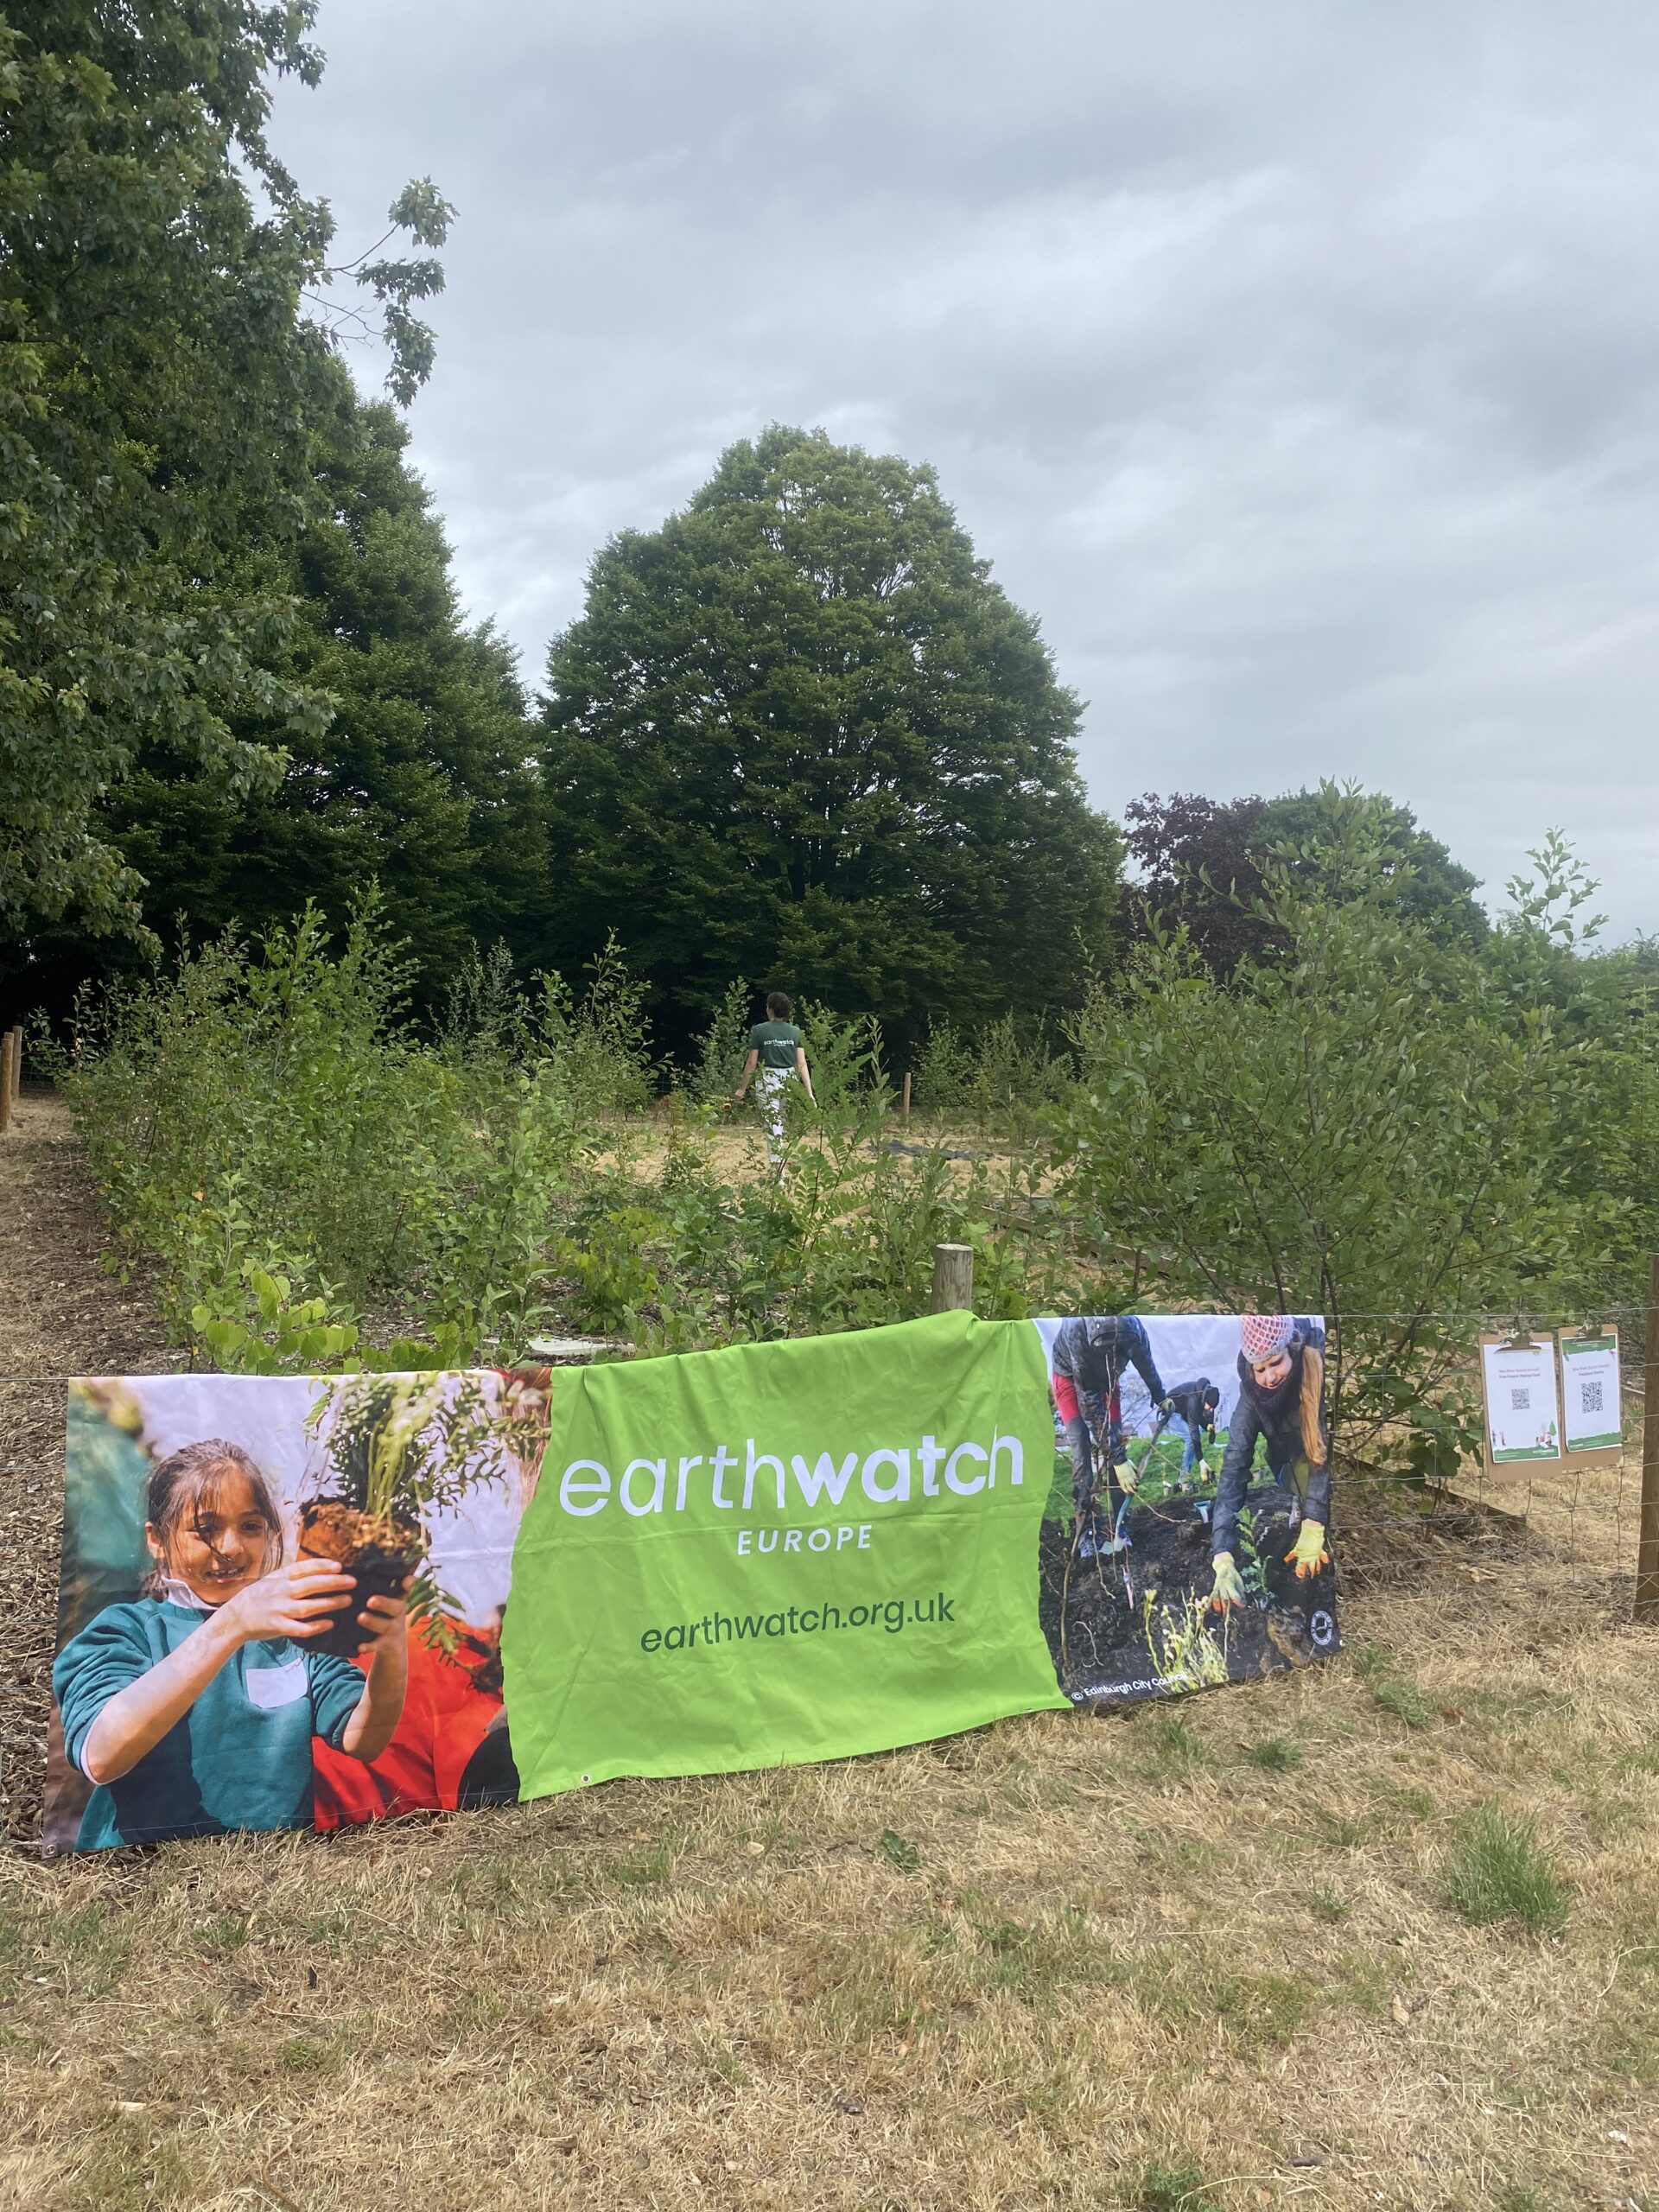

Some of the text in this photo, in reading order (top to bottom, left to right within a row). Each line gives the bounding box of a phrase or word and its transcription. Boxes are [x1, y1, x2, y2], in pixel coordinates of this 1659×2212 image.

[559, 1424, 1024, 1516] earthwatch
[737, 1525, 873, 1555] EUROPE
[640, 1592, 955, 1653] earthwatch.org.uk
[1084, 1682, 1132, 1696] Edinburgh
[1132, 1679, 1151, 1690] City
[1152, 1672, 1187, 1686] Council
